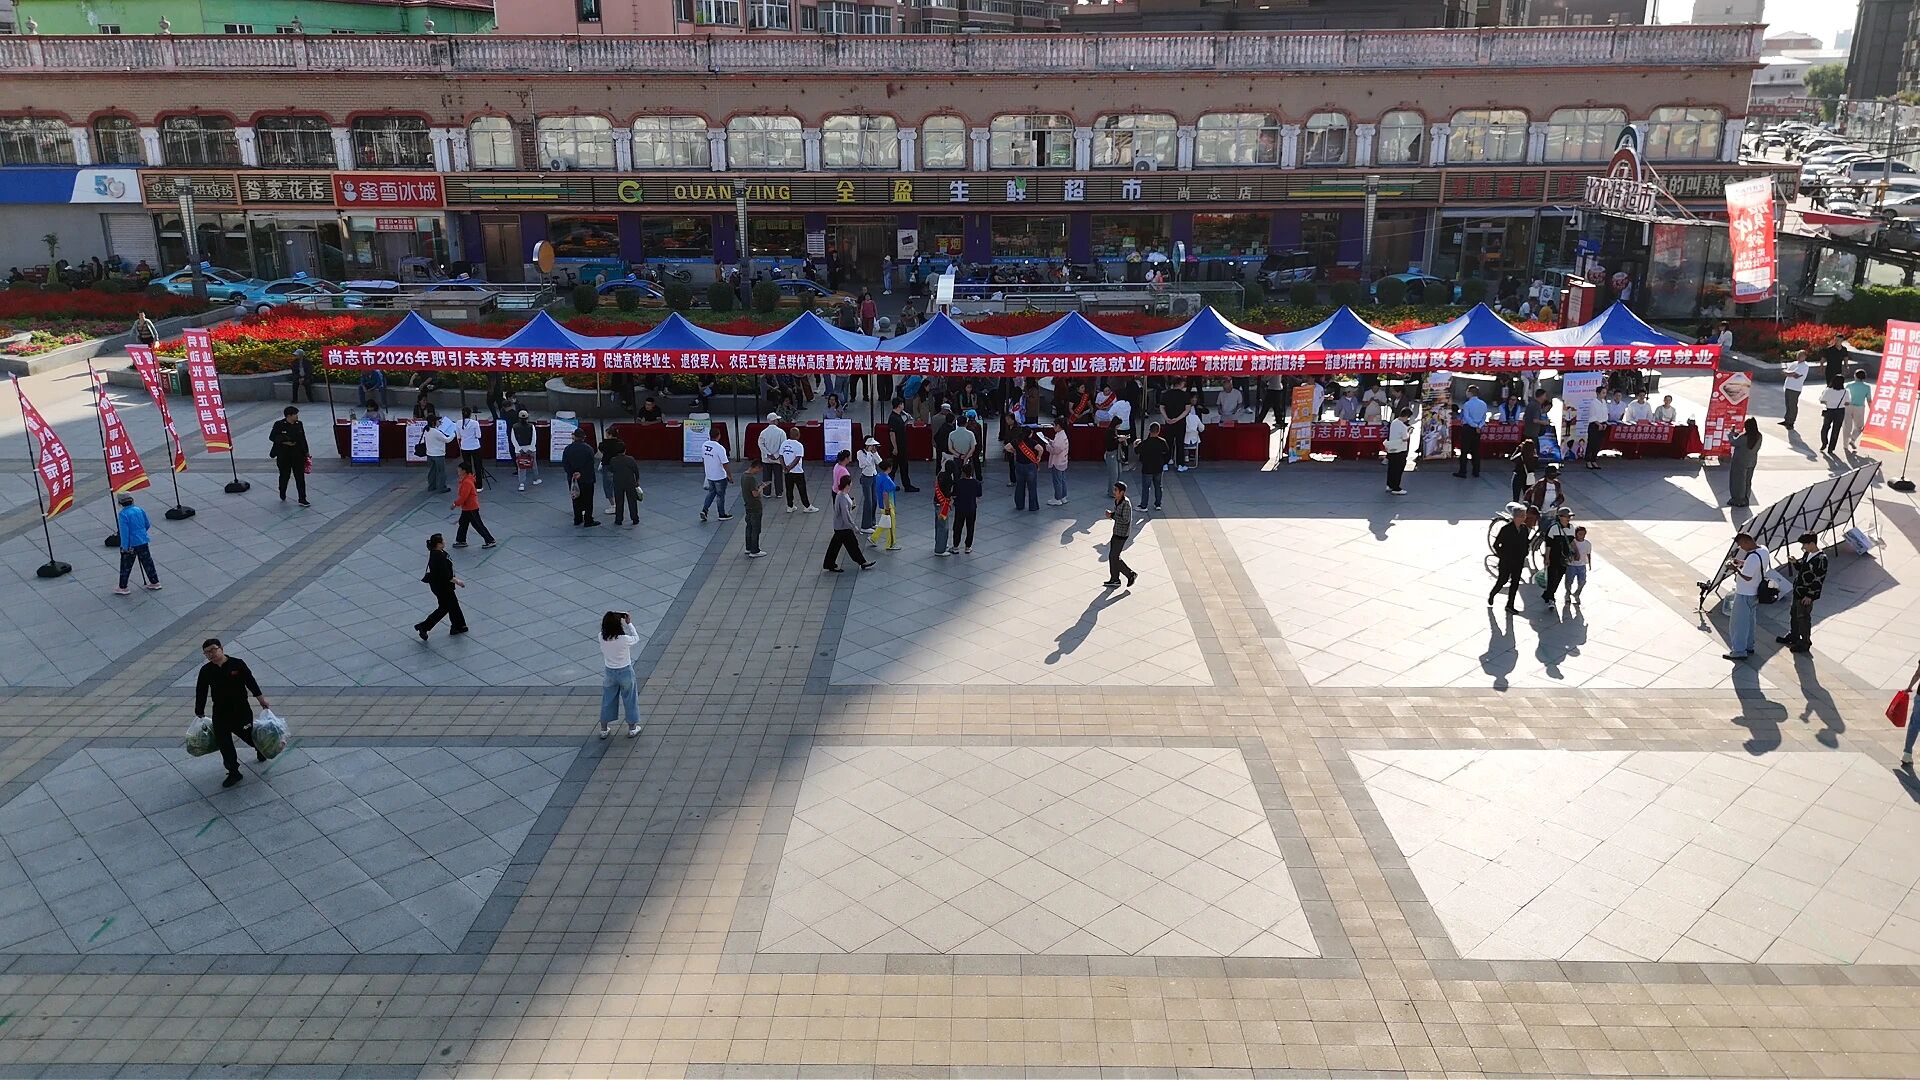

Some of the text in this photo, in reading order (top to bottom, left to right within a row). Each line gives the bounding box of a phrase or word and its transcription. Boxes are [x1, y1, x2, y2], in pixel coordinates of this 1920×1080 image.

[359, 181, 437, 201] 蜜雪冰城
[674, 184, 791, 200] QUANYING
[836, 177, 1143, 202] 全盈生鲜超市
[1177, 186, 1253, 201] 尚志店
[328, 350, 873, 371] 尚志市2026年职引未来专项招聘活动 促进高校毕业生、退役军人、农民工等重点群体高质量充分就业
[875, 355, 1145, 374] 精准培训提素质 护航创业稳就业
[1429, 349, 1715, 369] 政务市集惠民生 便民服务促就业
